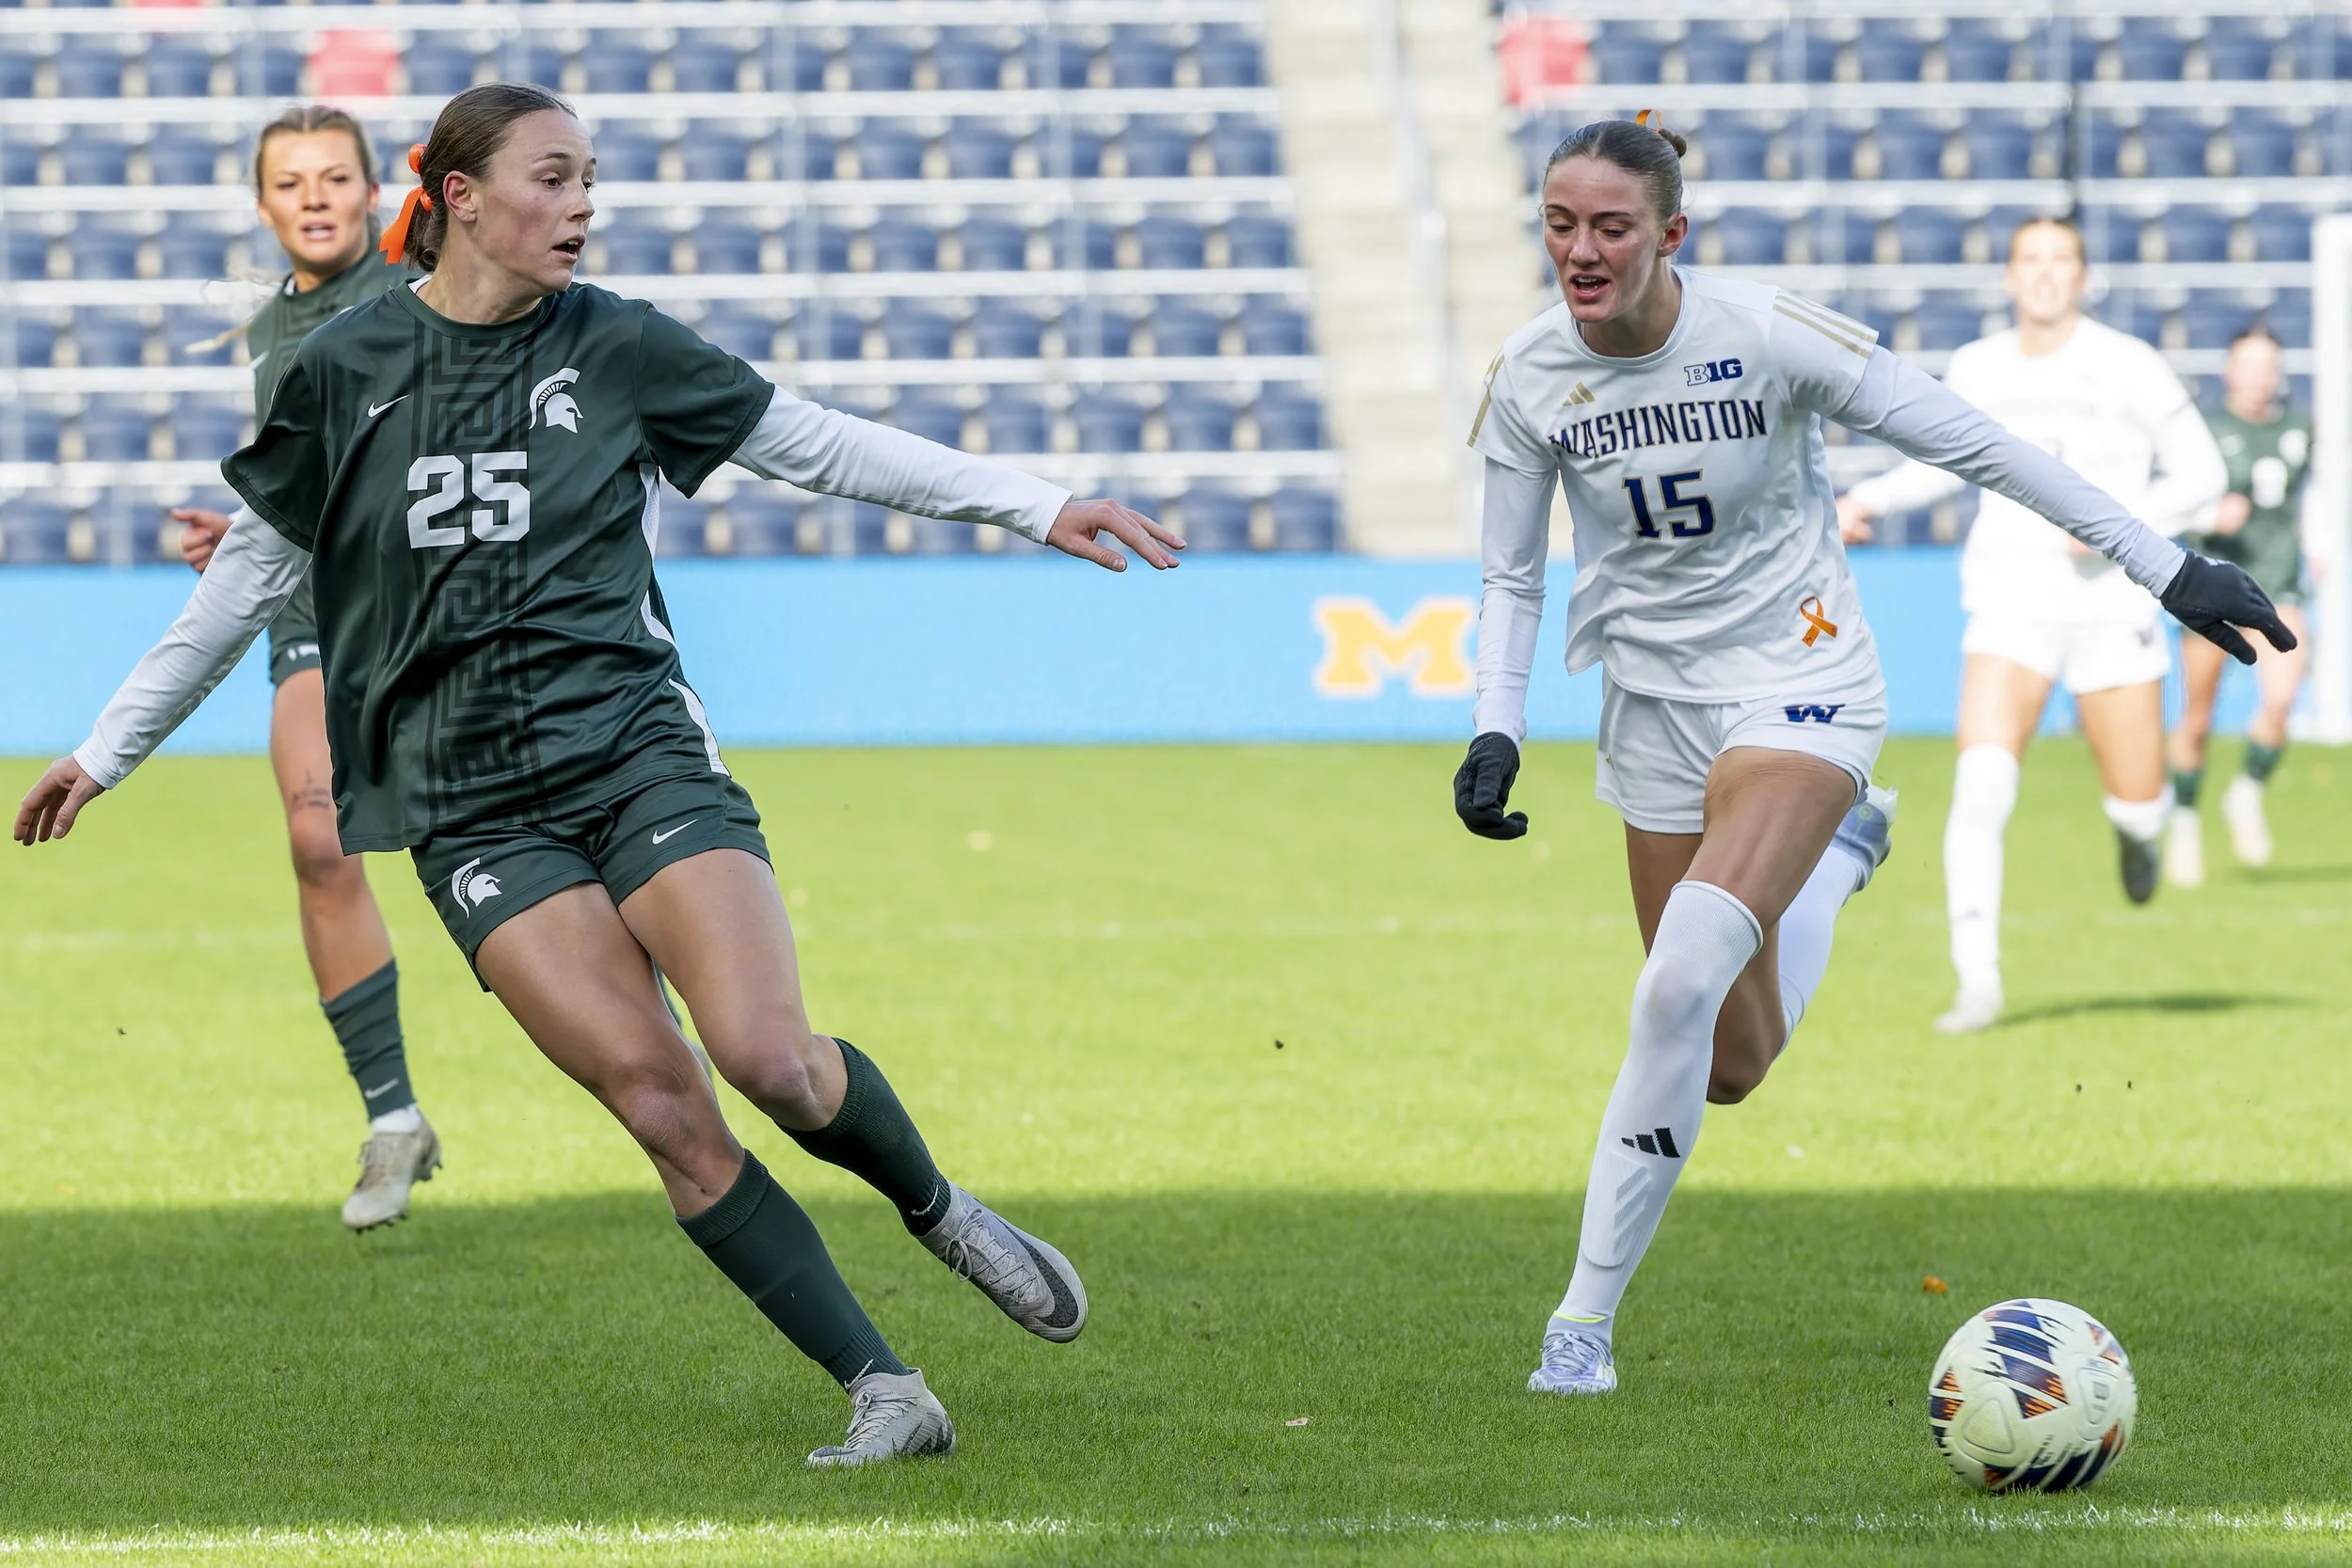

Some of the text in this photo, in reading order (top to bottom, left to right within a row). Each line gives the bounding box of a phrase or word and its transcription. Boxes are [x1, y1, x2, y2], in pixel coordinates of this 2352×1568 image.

[406, 451, 531, 549] 25
[1621, 468, 1717, 540] 15
[1313, 596, 1475, 699] M
[1781, 704, 1846, 723] W
